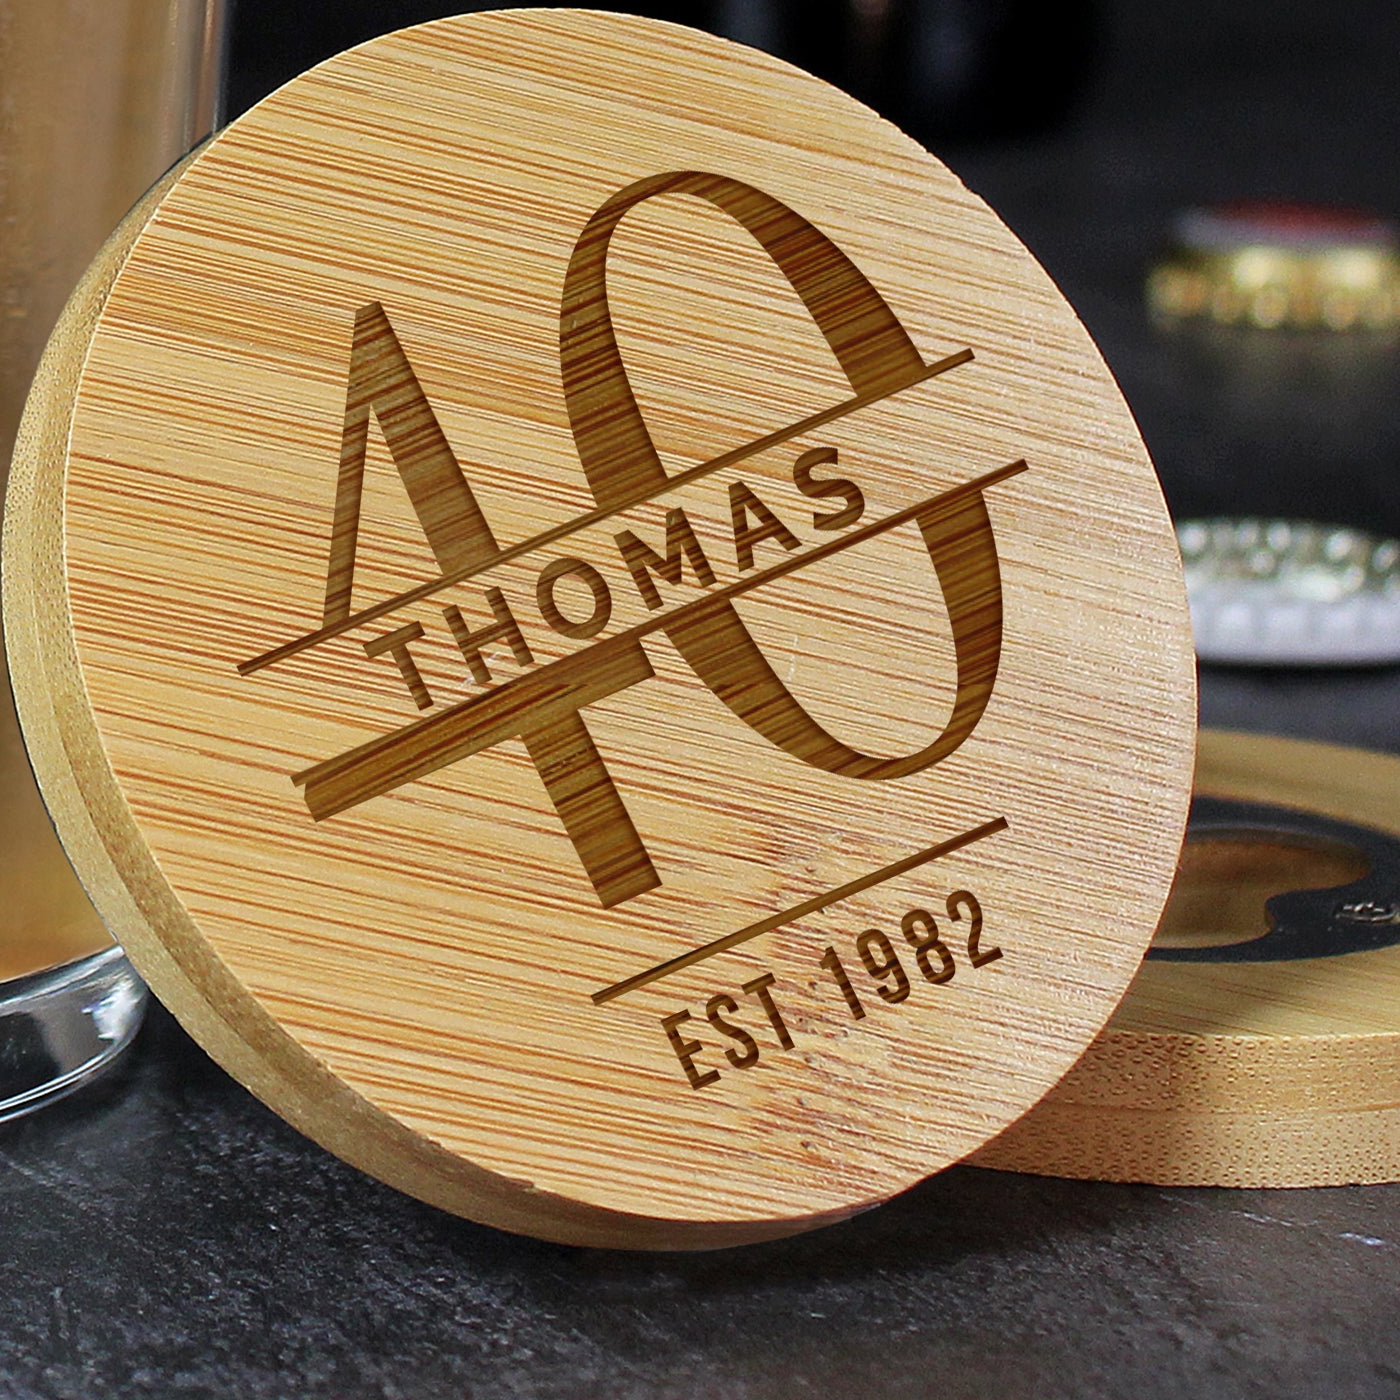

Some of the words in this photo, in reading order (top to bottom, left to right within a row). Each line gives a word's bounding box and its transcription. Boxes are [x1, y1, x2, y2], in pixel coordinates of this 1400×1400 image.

[363, 447, 866, 711] THOMAS
[660, 972, 796, 1091] EST
[819, 889, 1003, 1021] 1982
